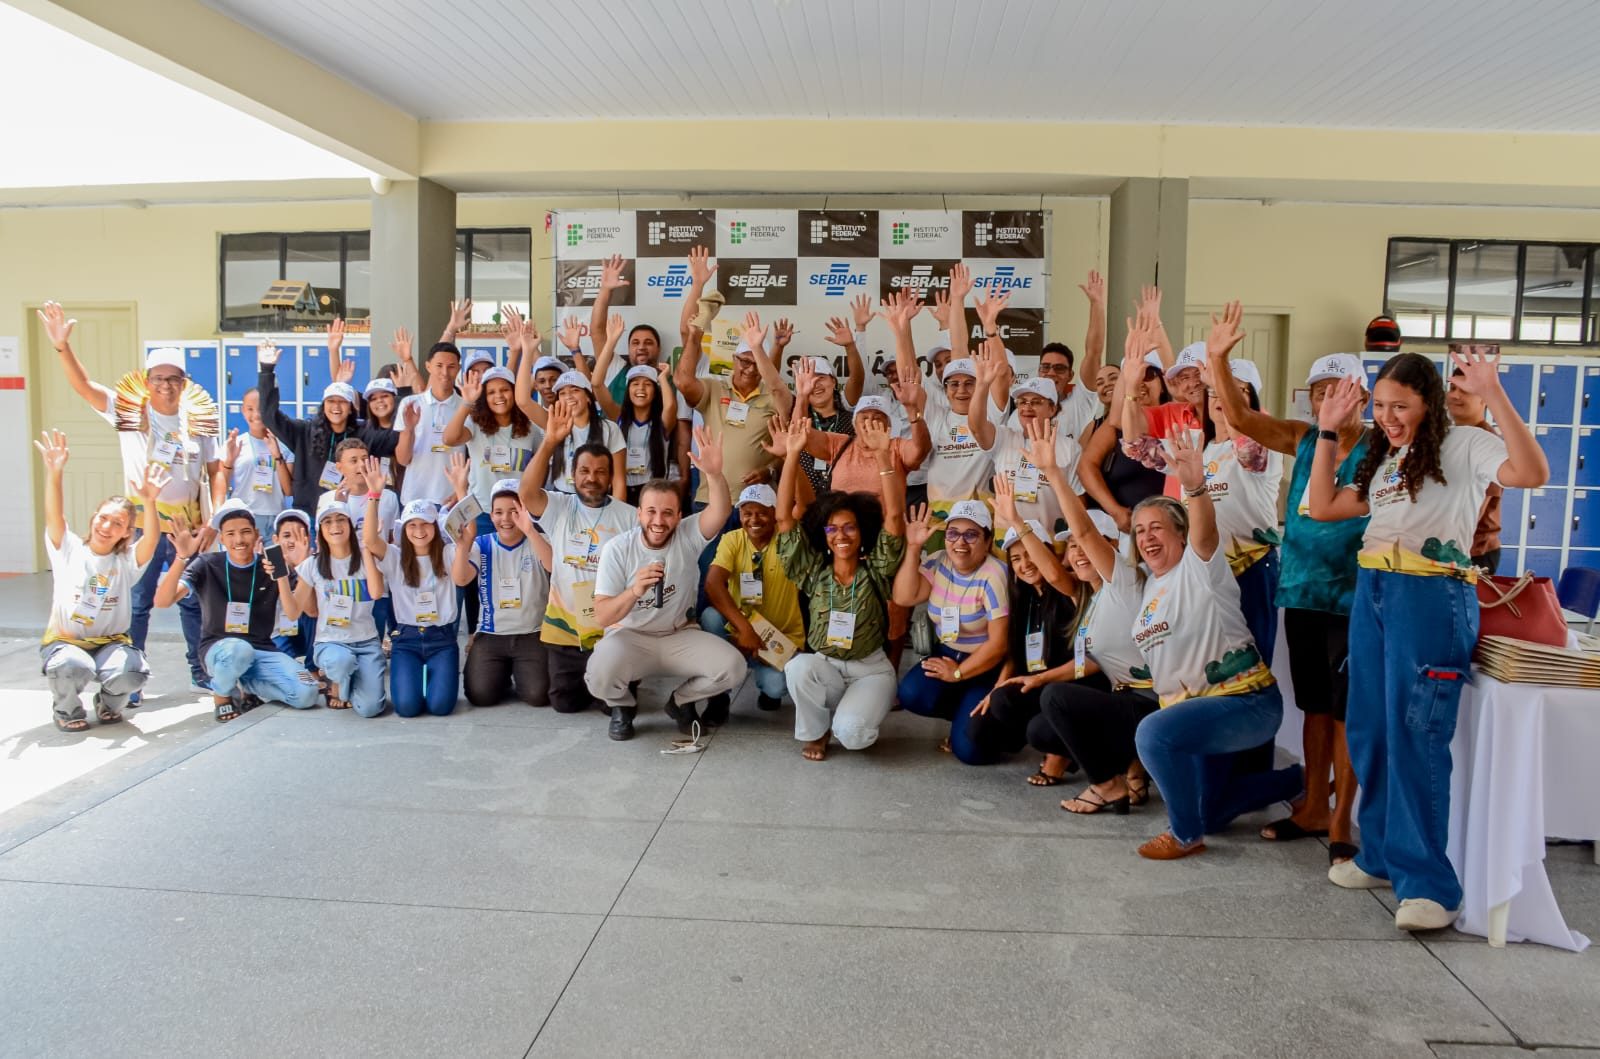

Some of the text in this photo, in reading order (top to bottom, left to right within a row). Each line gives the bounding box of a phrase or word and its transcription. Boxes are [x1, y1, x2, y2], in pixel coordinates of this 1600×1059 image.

[647, 275, 693, 287] SEBRA
[728, 274, 788, 287] SEBRAE
[809, 274, 867, 285] SEBRAE
[890, 276, 951, 288] SEBRAE
[974, 277, 1032, 288] SEBRAE
